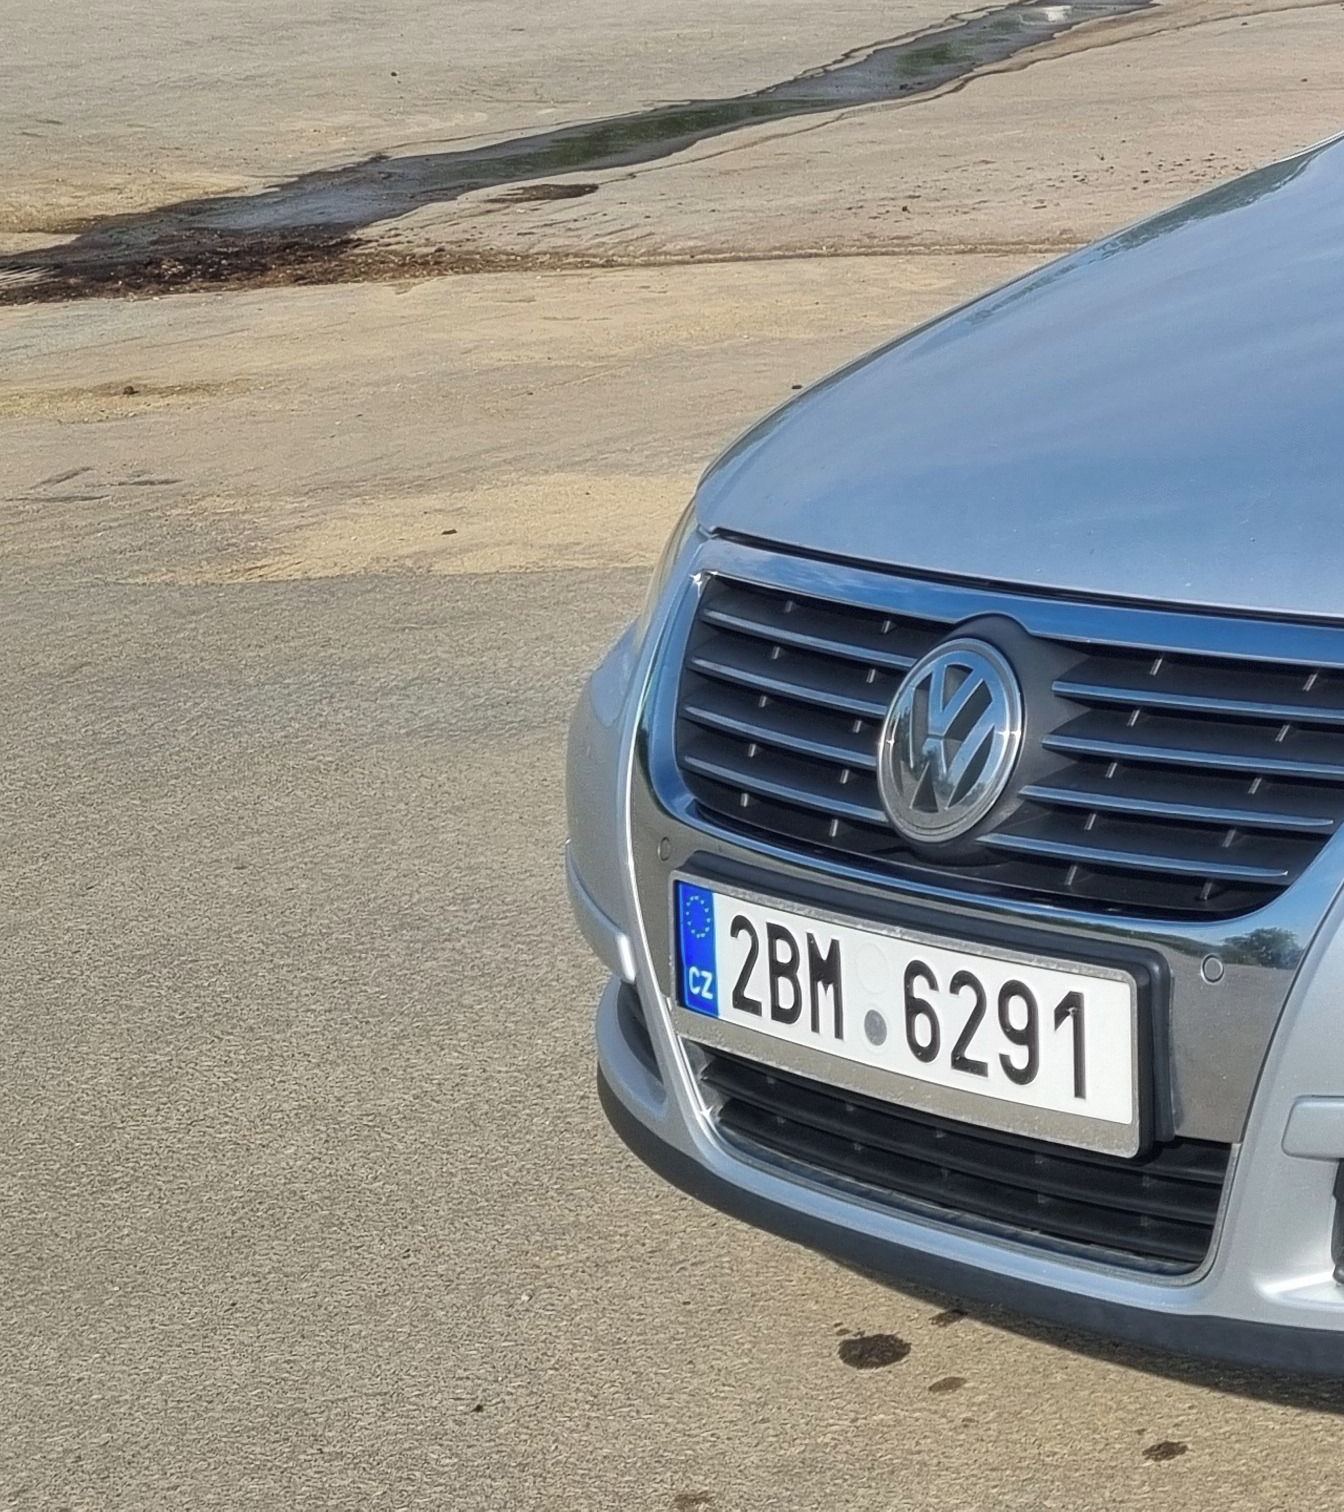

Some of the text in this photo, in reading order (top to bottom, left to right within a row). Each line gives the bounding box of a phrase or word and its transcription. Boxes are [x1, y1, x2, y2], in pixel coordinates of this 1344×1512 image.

[892, 649, 1010, 829] VW
[688, 964, 714, 1000] CZ
[729, 914, 1087, 1099] 2BM 6291
